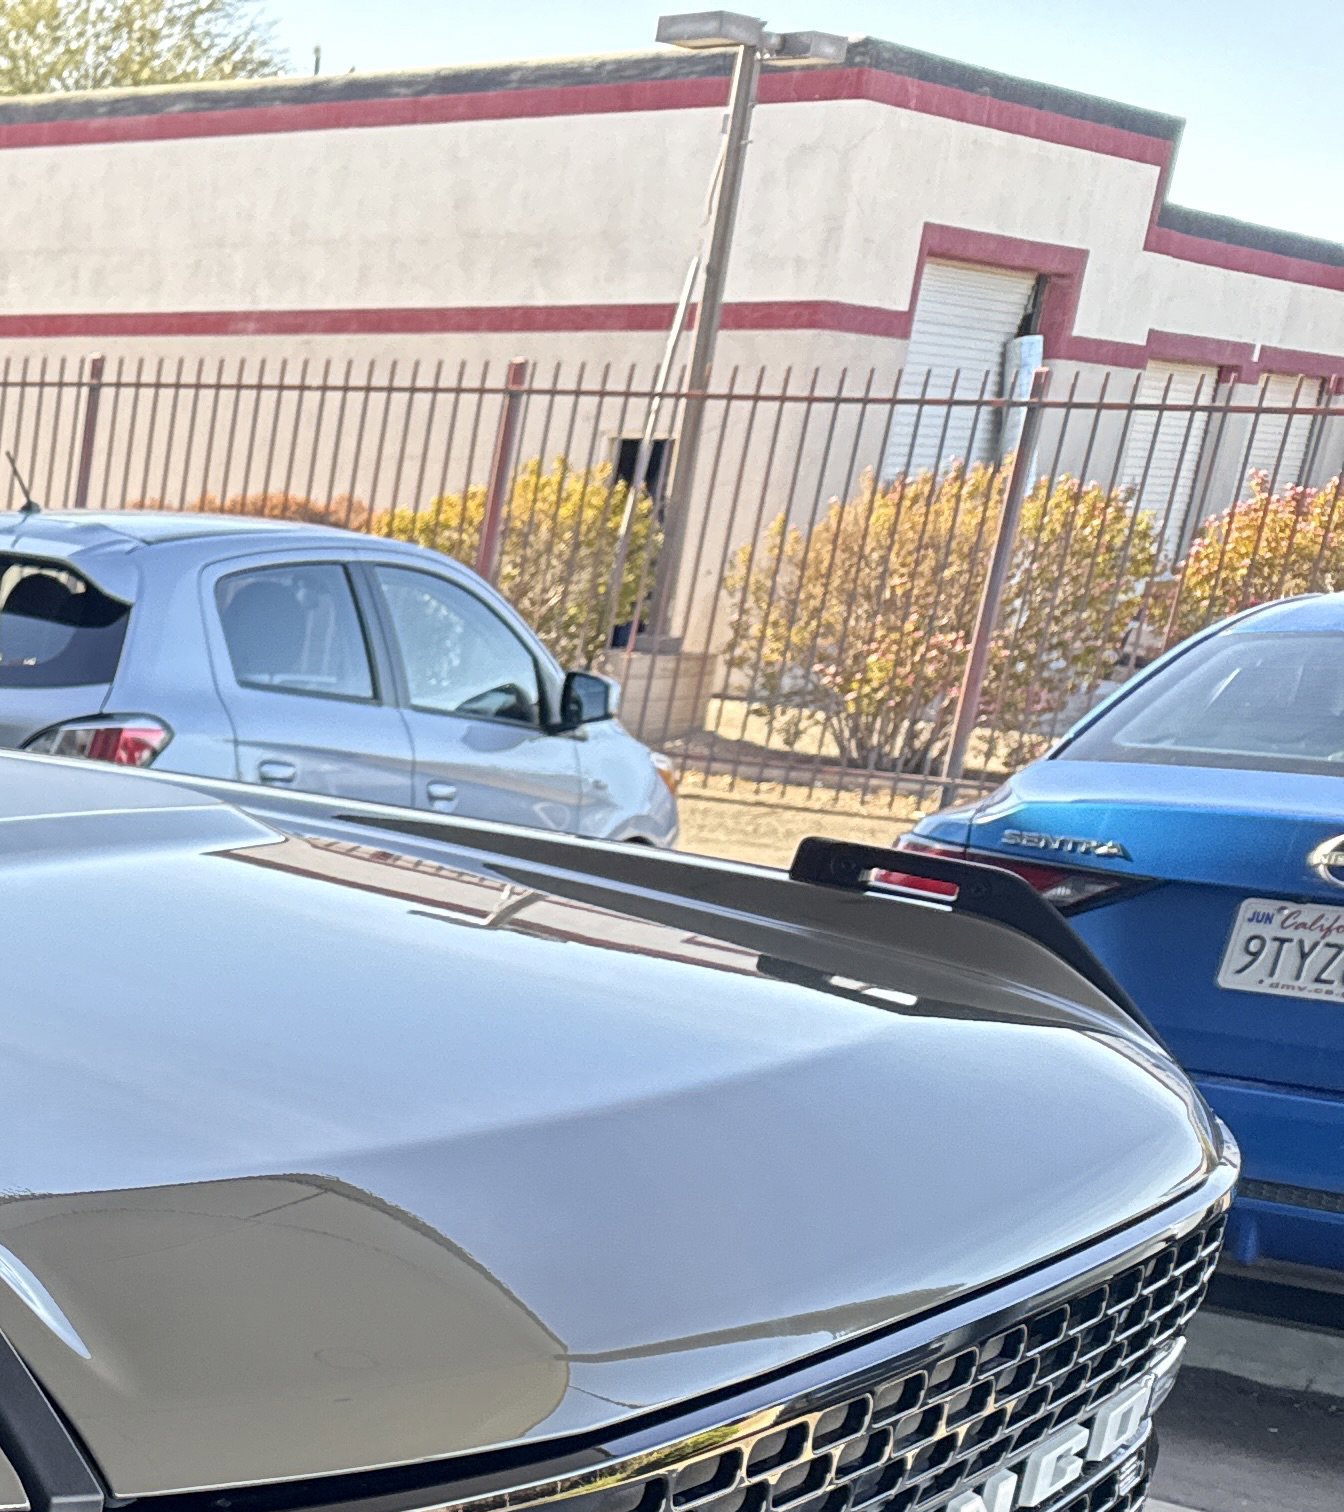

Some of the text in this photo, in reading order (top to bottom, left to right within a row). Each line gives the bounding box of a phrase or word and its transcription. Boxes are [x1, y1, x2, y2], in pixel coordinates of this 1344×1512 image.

[1001, 829, 1131, 861] SENTRA
[1247, 911, 1274, 925] JUN
[1234, 934, 1344, 985] 9TYZ
[1269, 982, 1344, 999] dmv.ca.
